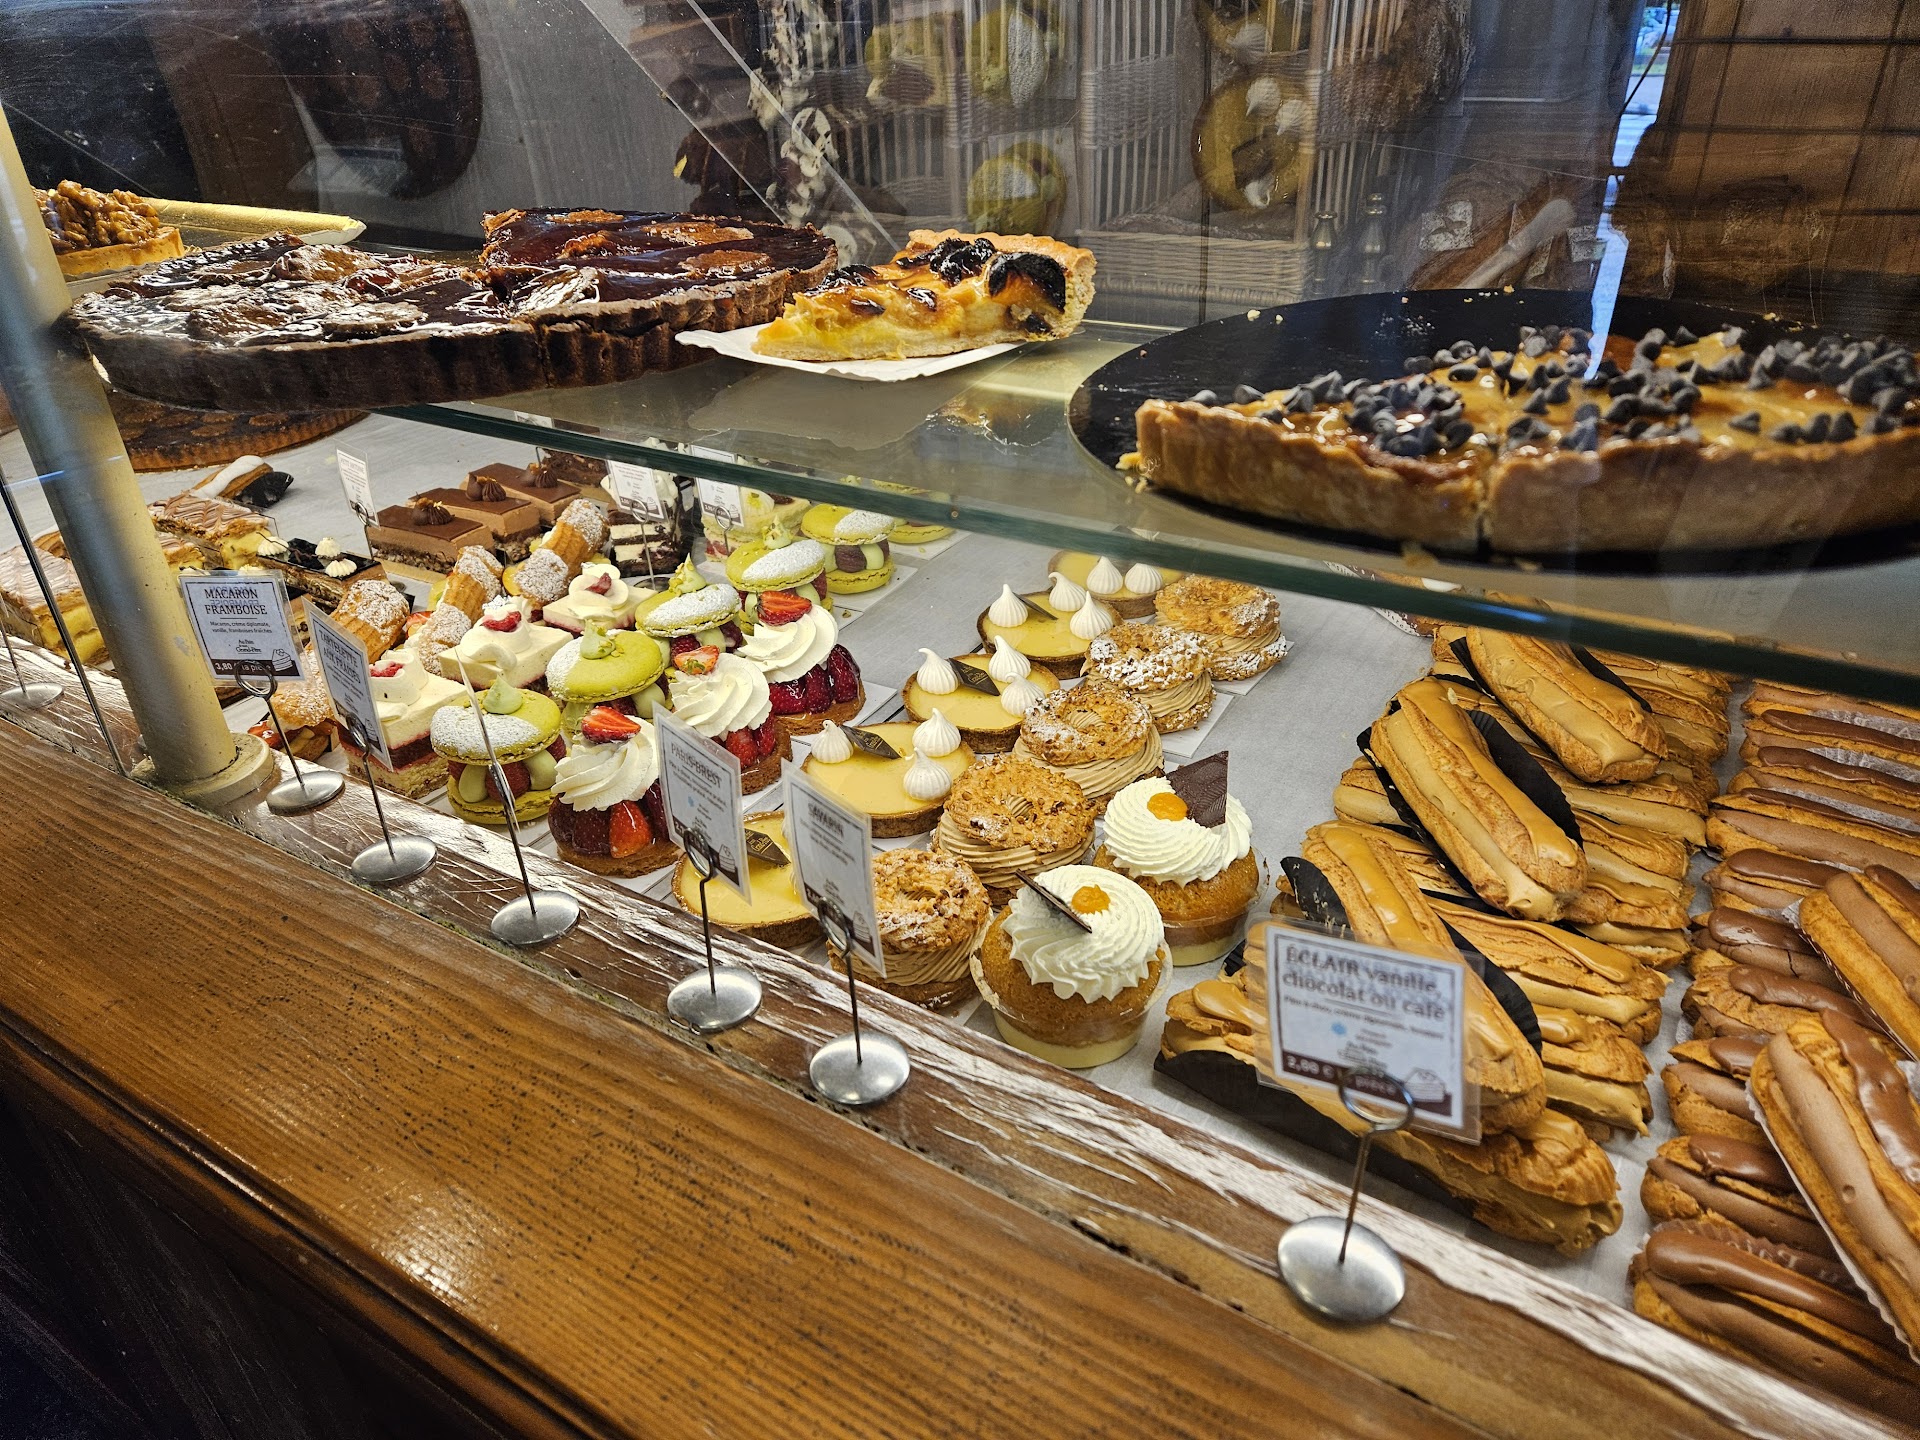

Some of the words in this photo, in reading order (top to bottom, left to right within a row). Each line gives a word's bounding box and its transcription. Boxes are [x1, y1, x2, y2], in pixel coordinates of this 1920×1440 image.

[204, 588, 258, 599] MACARON
[204, 604, 268, 615] FRAMBOISE
[214, 662, 233, 671] 3,80
[671, 742, 722, 788] PARIS-BREST
[1286, 944, 1361, 977] ÉCLAIR
[1366, 967, 1442, 999] vanille,
[1282, 970, 1365, 1002] chocolat
[1369, 993, 1396, 1011] ou
[1402, 1000, 1445, 1022] café
